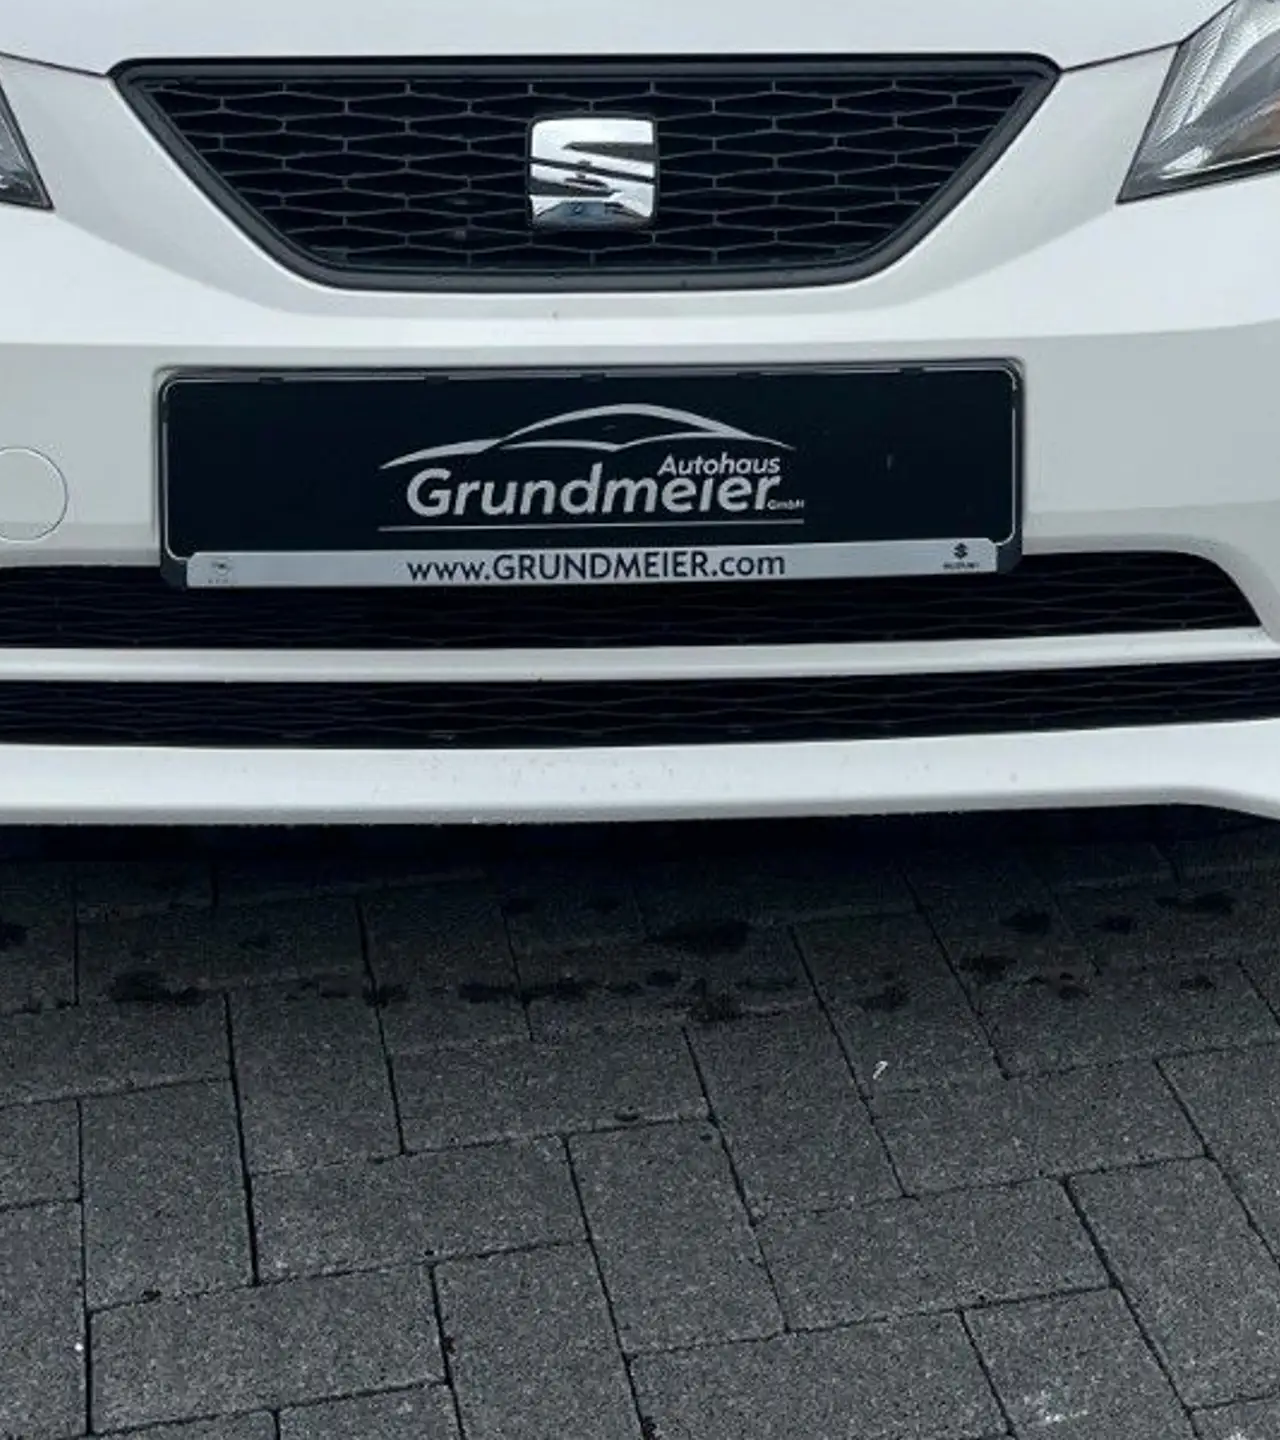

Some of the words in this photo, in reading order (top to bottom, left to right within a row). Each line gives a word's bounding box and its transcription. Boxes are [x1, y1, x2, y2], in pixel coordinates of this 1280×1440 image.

[657, 452, 781, 477] Autohaus
[406, 463, 781, 517] Grundmeier
[407, 551, 786, 582] www.GRUNDMEIER.com
